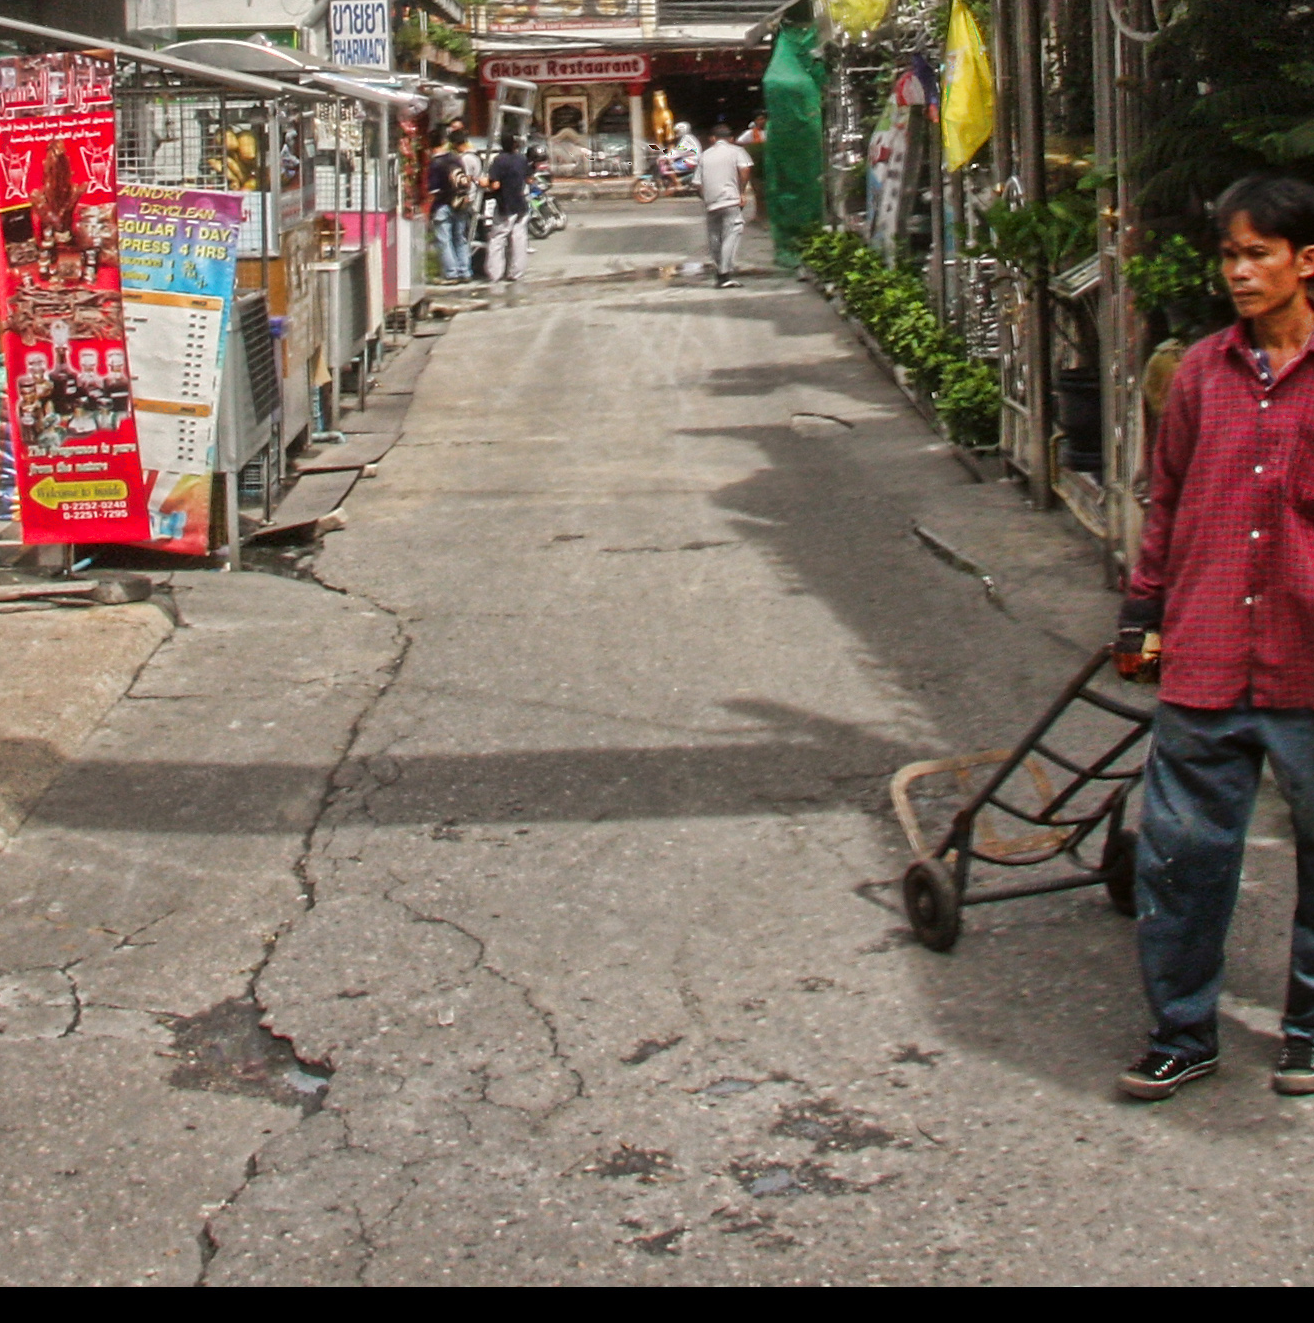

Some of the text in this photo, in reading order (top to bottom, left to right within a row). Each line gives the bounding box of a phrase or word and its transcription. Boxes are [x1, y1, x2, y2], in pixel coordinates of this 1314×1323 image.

[333, 2, 386, 35] ขายยา
[333, 38, 387, 65] PHARMACY
[490, 57, 641, 79] Akbar Restaurant
[117, 185, 187, 201] AUNDRY
[139, 202, 217, 220] DRYCLEAN
[118, 218, 177, 237] EGULAR
[184, 226, 193, 238] 1
[119, 237, 173, 255] PRESS
[179, 243, 191, 256] 4
[28, 460, 108, 476] from the nature
[36, 485, 77, 499] Welcome
[81, 486, 92, 498] to
[62, 500, 127, 512] 0-2252-0240
[63, 509, 128, 521] 0-2251-7295
